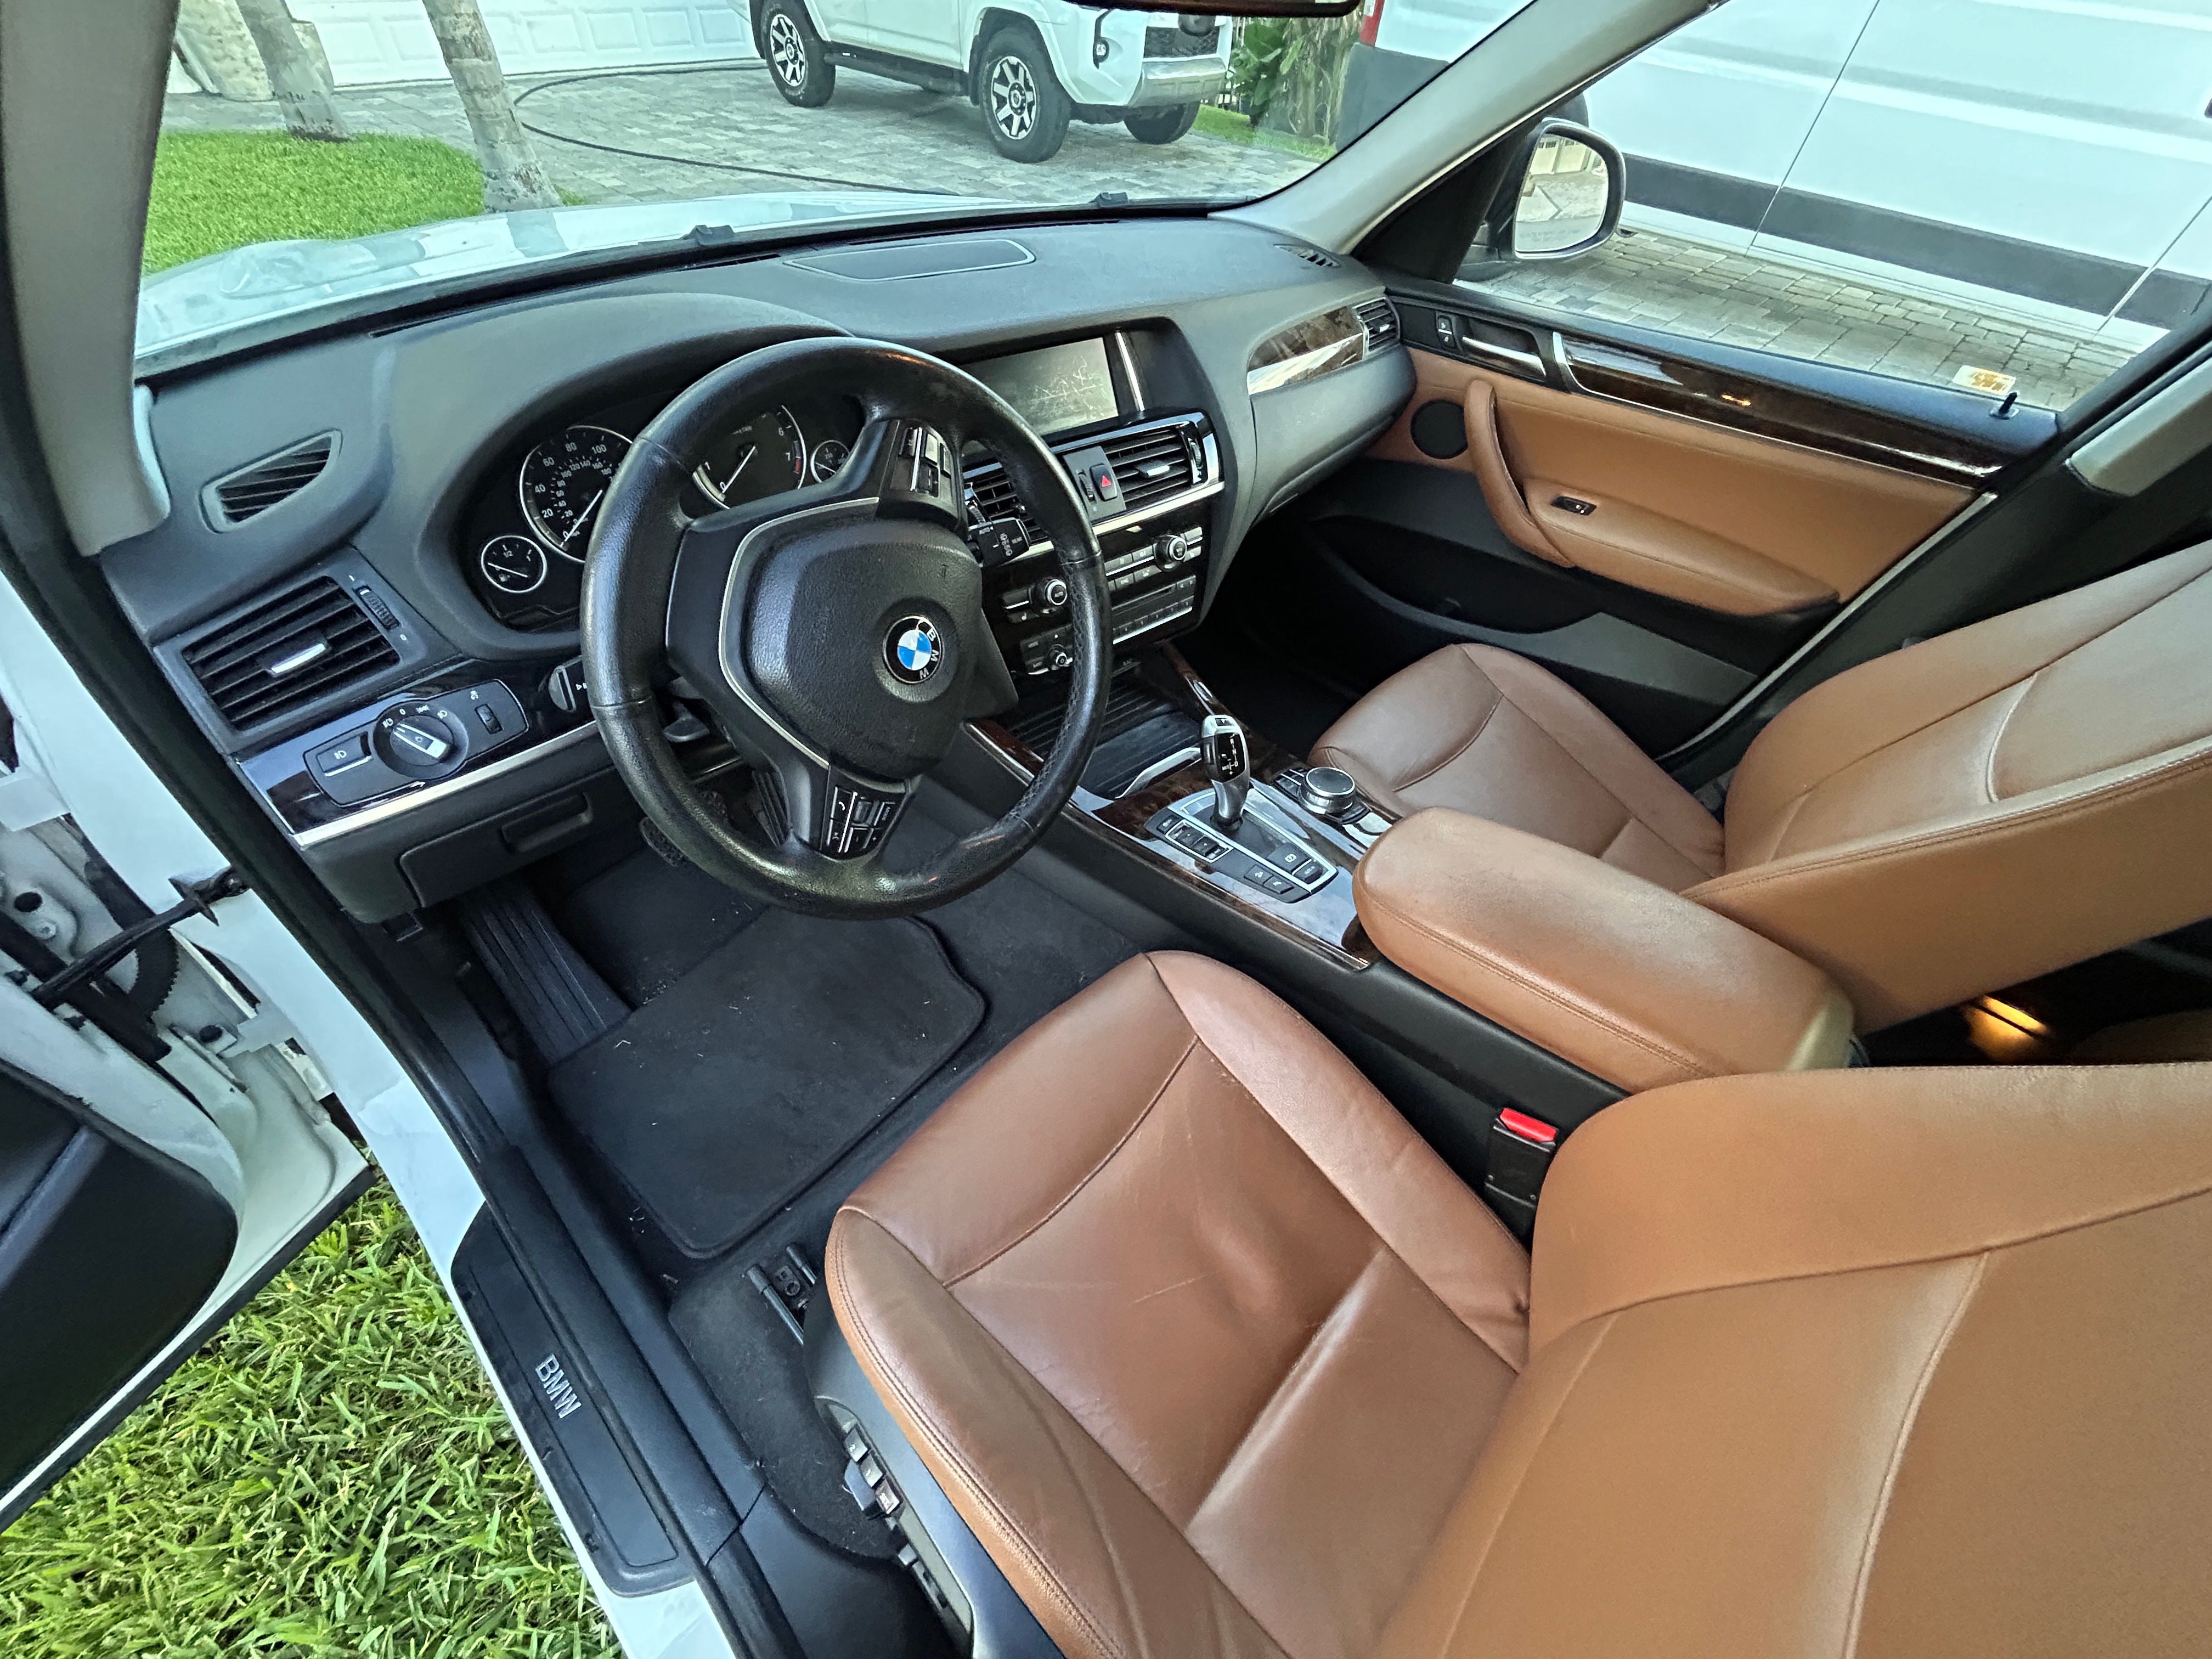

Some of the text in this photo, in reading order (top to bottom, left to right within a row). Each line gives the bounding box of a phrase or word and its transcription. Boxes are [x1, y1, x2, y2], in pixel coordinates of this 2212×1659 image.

[778, 427, 784, 436] 6
[565, 442, 577, 452] 80
[592, 444, 607, 454] 100
[543, 456, 555, 466] 60
[786, 452, 791, 461] 7
[534, 484, 546, 494] 40
[541, 508, 554, 518] 20
[918, 627, 940, 680] BMW
[535, 1352, 582, 1419] BMW
